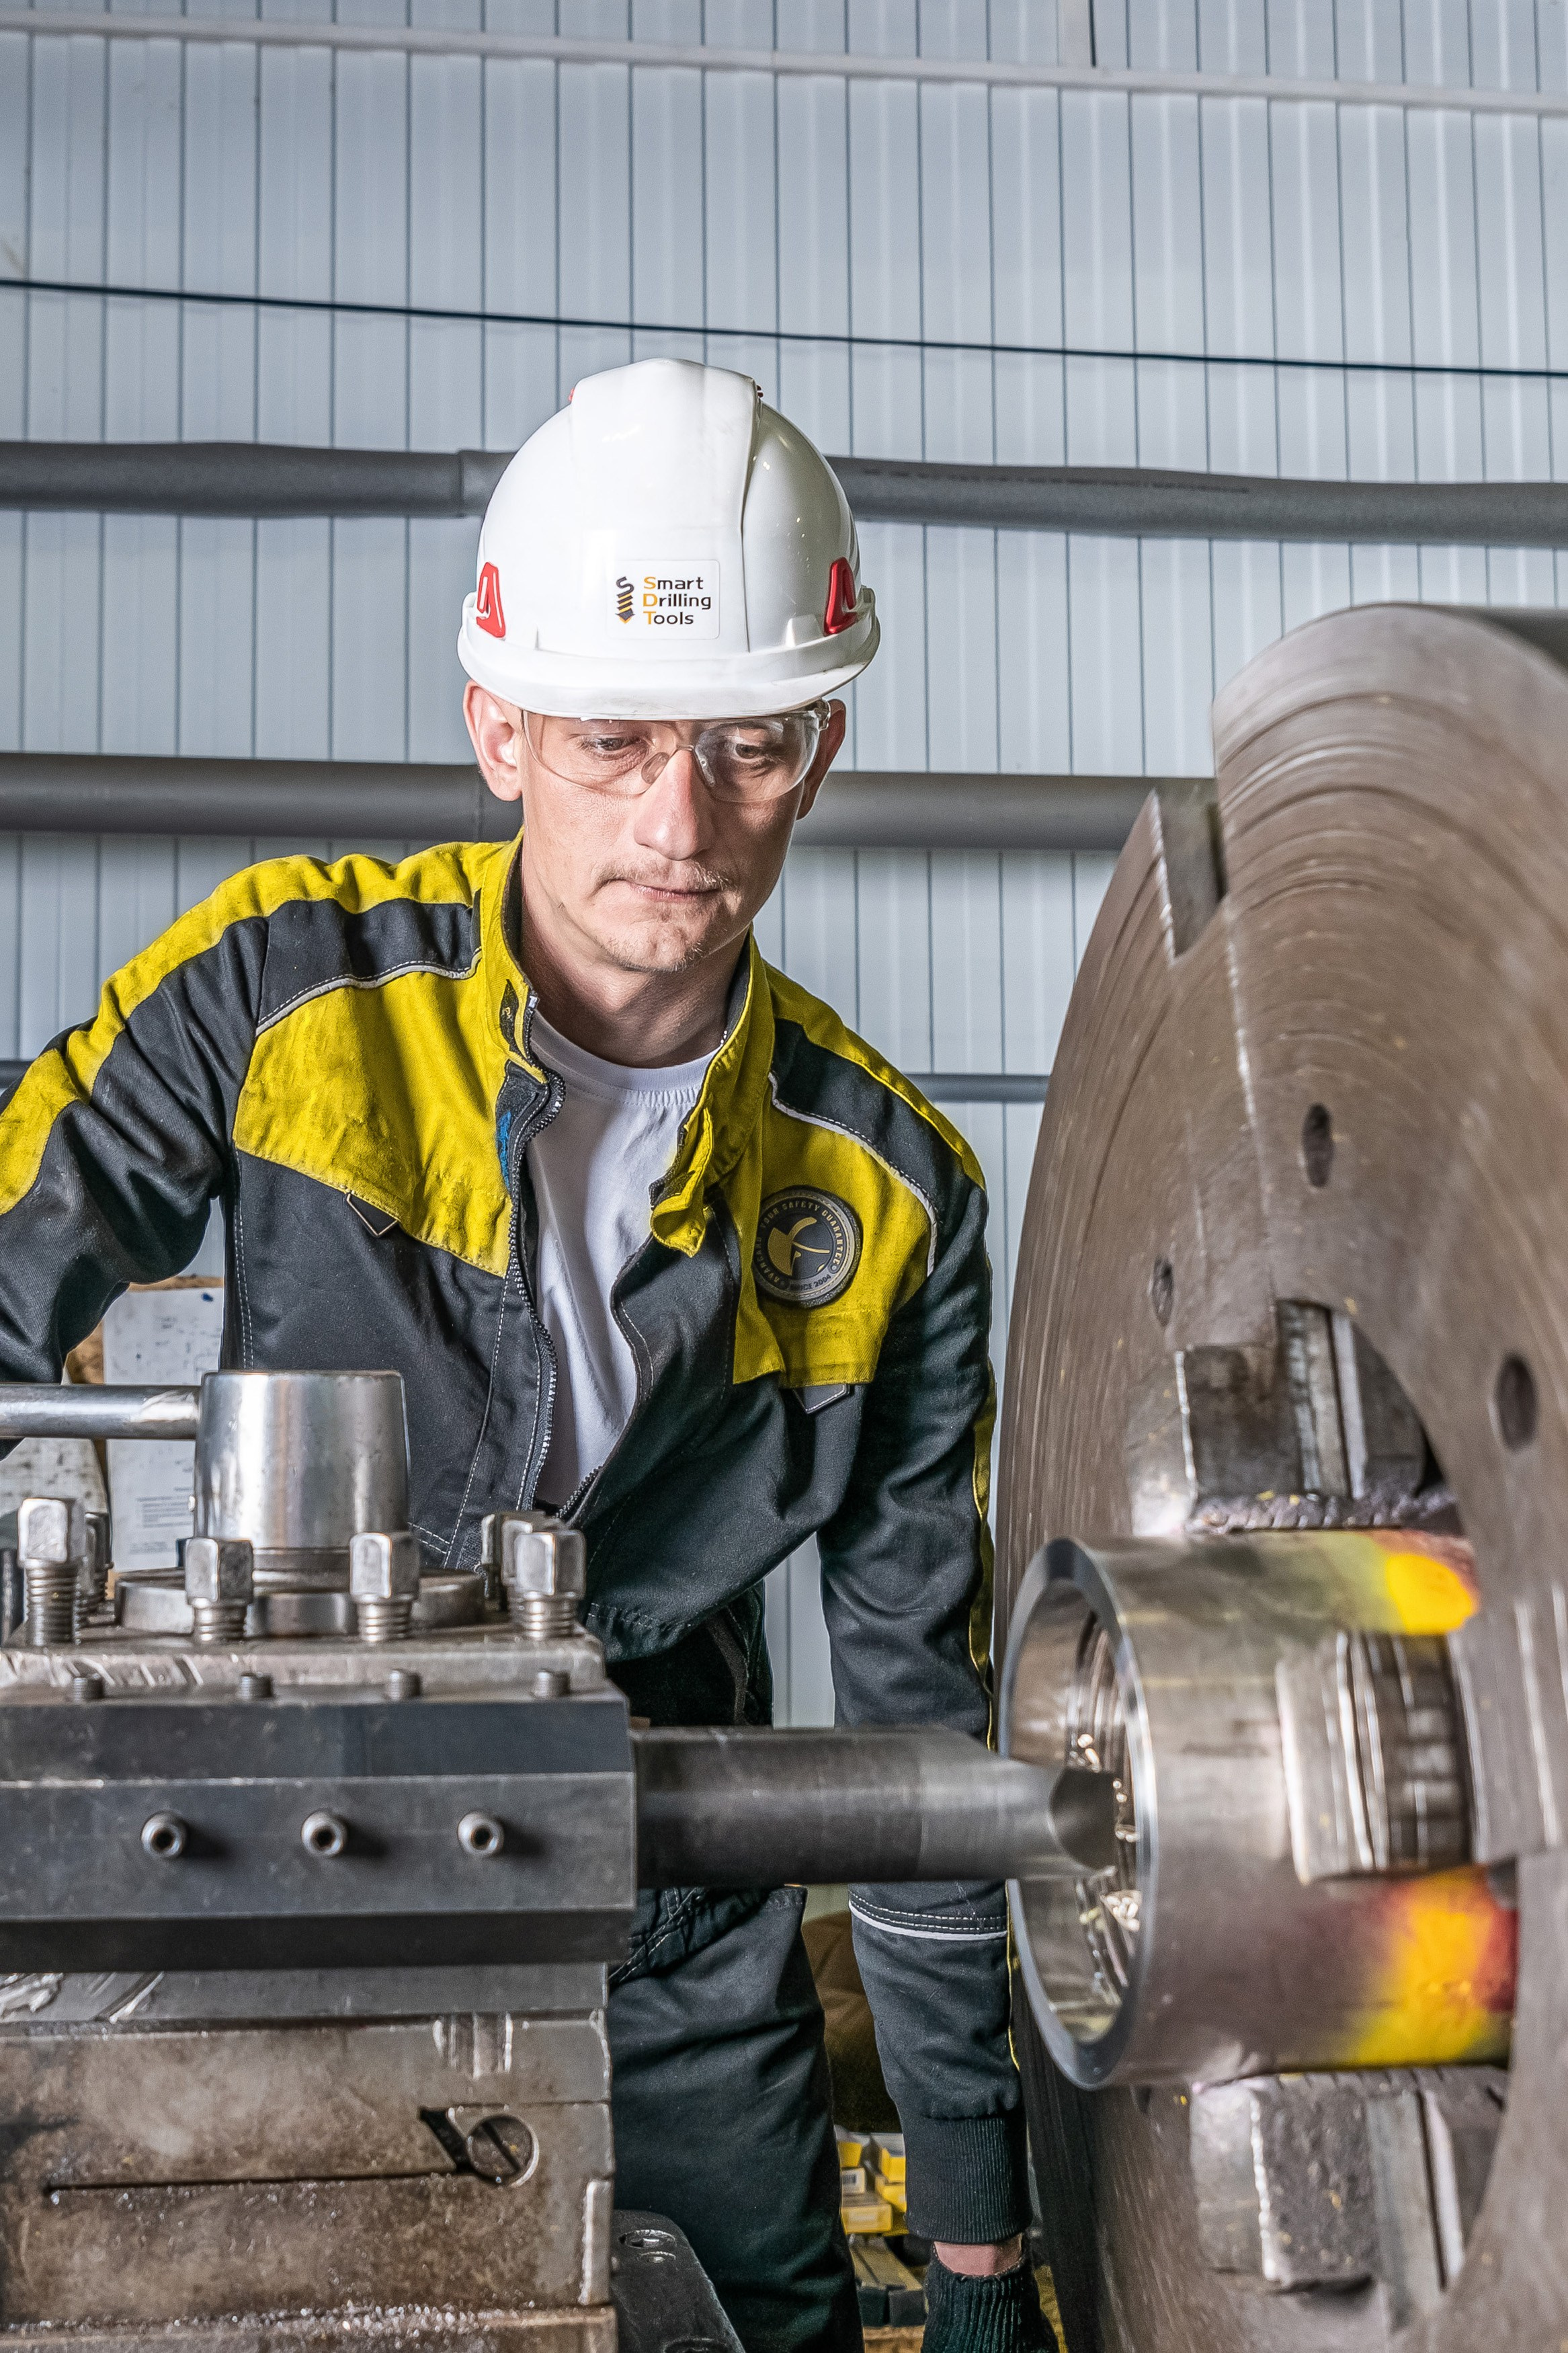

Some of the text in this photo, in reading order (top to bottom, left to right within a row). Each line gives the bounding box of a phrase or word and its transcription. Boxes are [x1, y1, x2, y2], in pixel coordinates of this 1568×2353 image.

[643, 576, 704, 590] Smart
[643, 593, 712, 610] Drilling
[643, 611, 694, 625] Tools
[759, 1201, 844, 1265] YOUR SAFETY GUARANTEE
[813, 1274, 832, 1287] 2004
